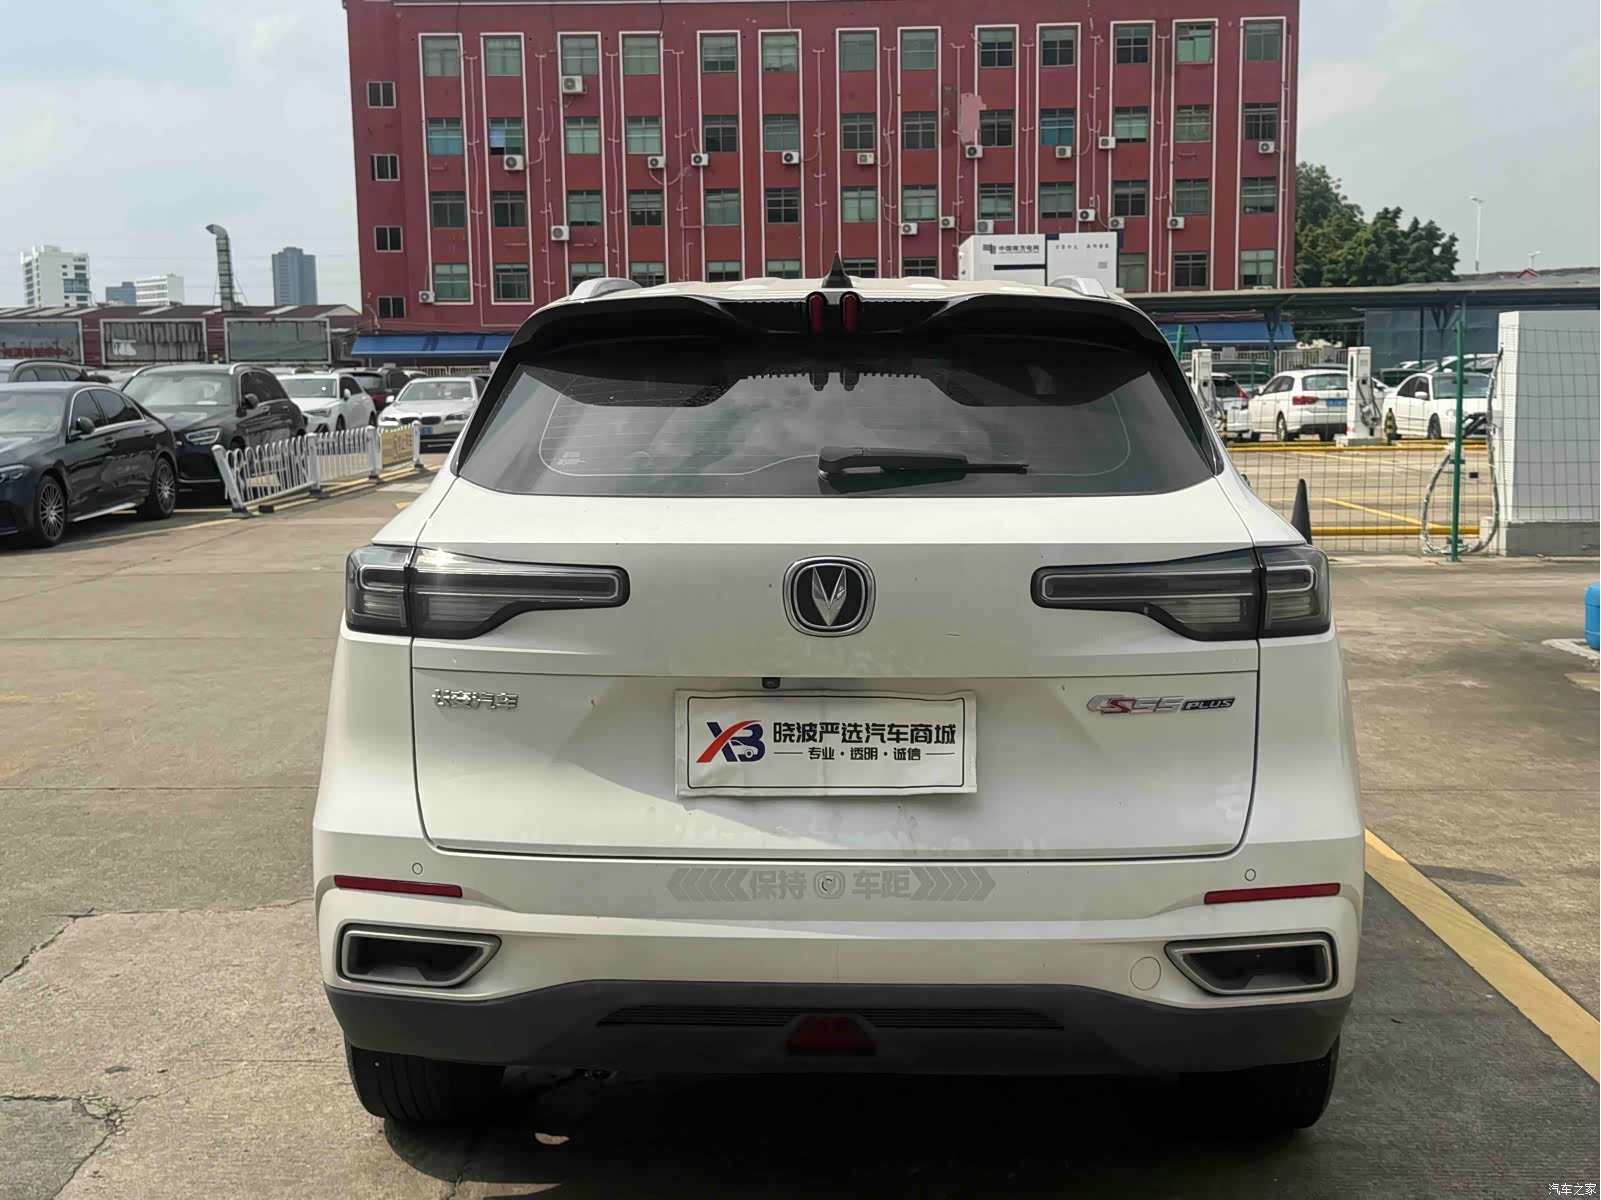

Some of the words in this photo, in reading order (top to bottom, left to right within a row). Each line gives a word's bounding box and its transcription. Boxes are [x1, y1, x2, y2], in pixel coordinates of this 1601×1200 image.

[1184, 698, 1234, 711] PLUS
[773, 722, 957, 745] 晓波严选汽车商城
[750, 869, 808, 900] 保持
[852, 869, 911, 900] 车距
